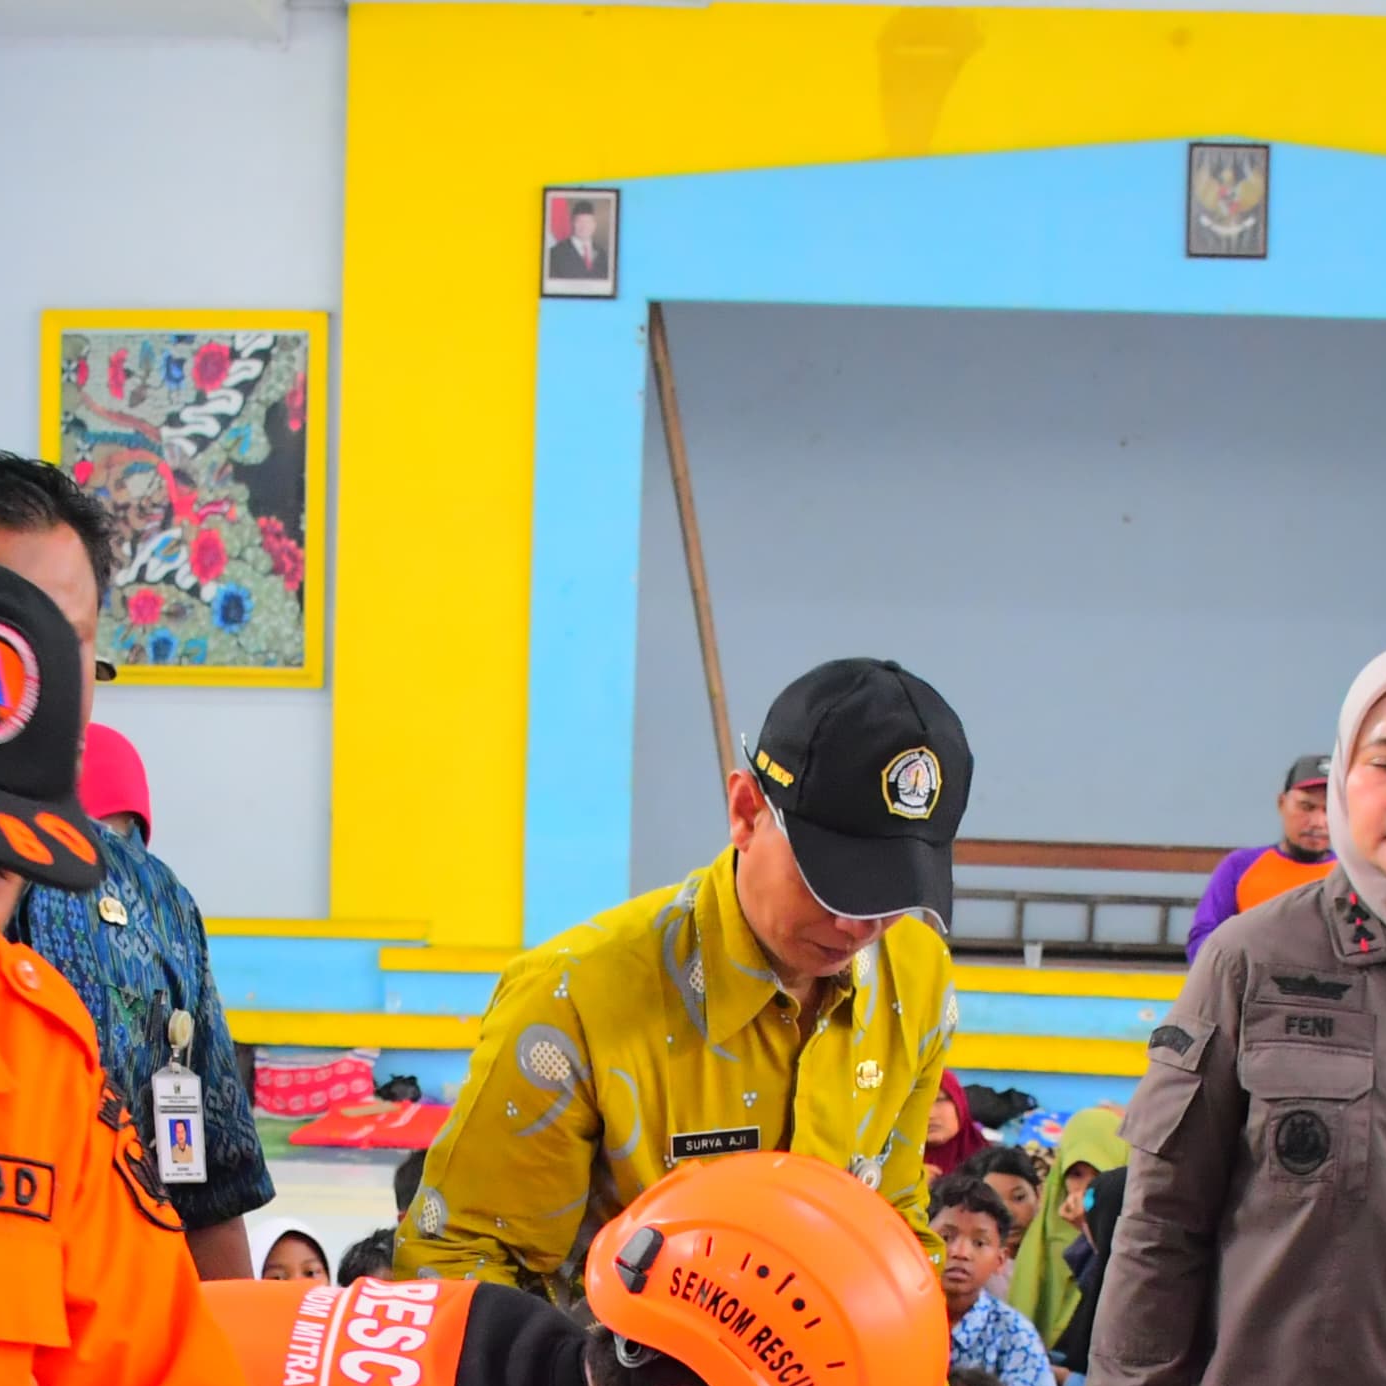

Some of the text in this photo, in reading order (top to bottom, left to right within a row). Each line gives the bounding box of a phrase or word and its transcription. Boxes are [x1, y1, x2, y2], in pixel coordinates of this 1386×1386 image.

[1285, 1015, 1334, 1038] FENI
[685, 1135, 747, 1151] SURYA AJI
[669, 1267, 757, 1338] SENKOM
[283, 1320, 326, 1386] MITRA
